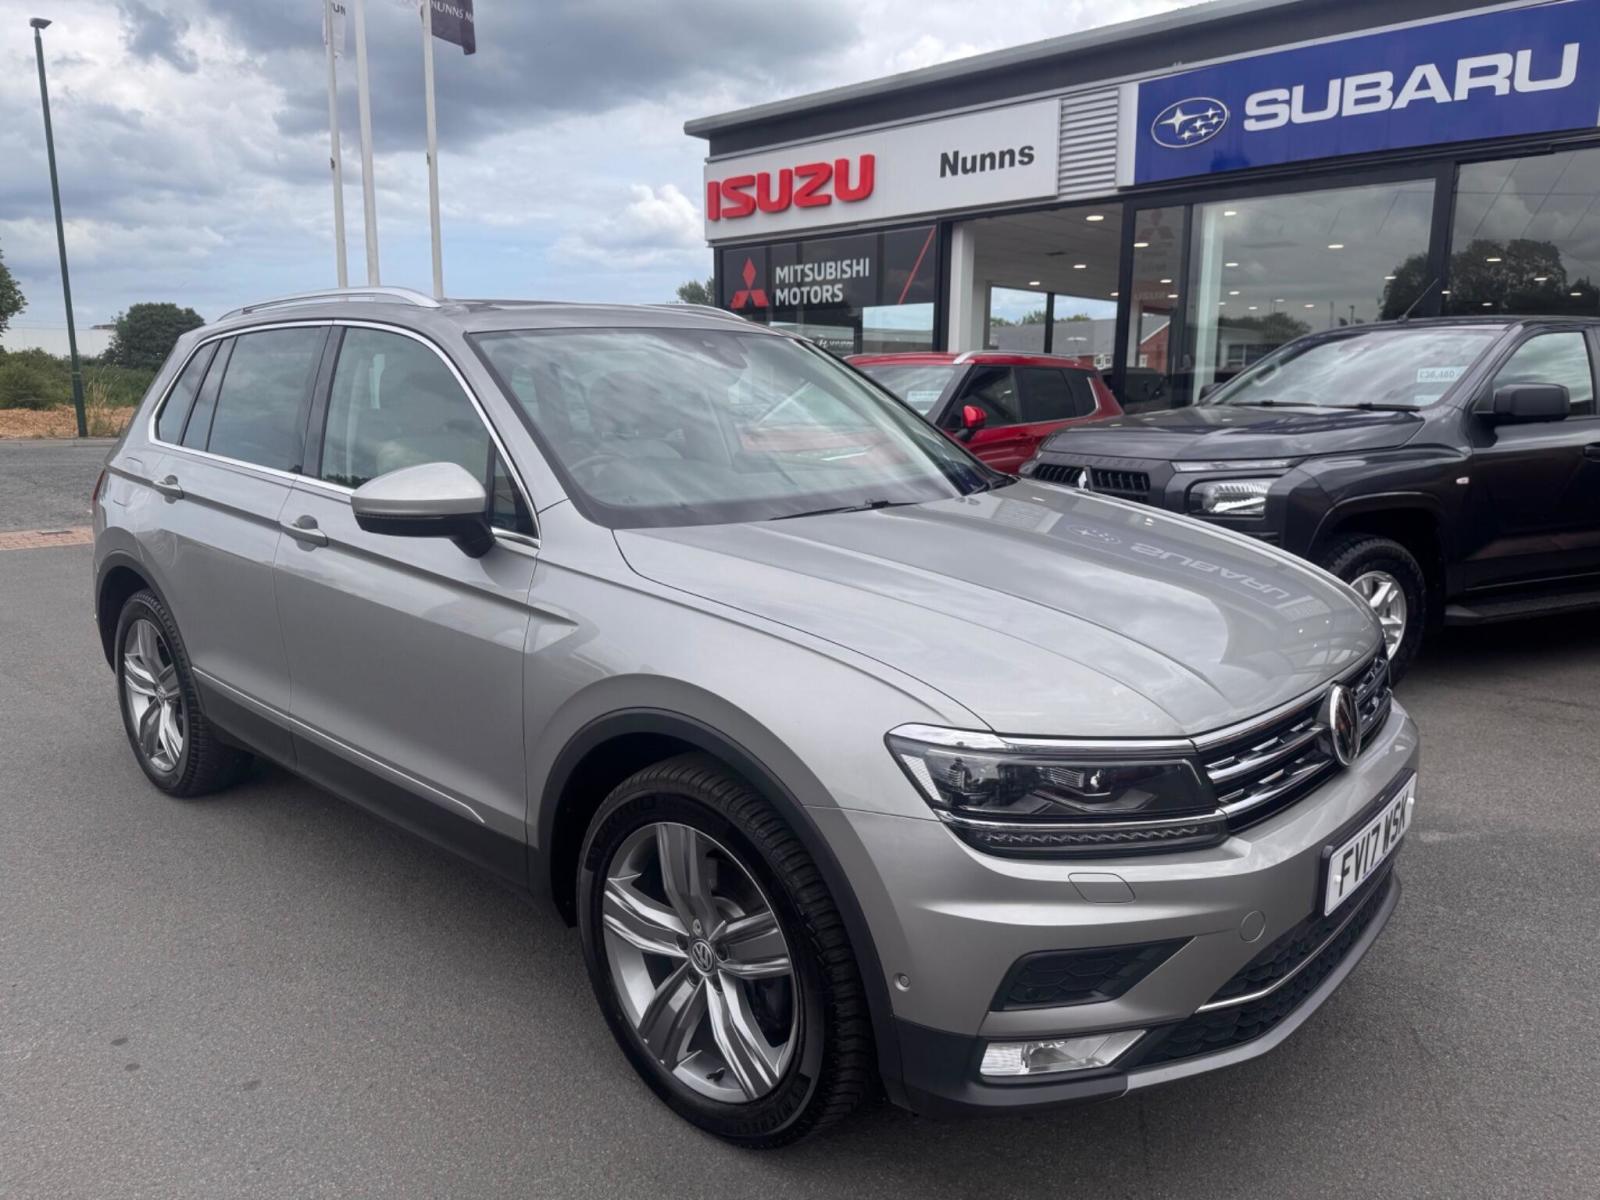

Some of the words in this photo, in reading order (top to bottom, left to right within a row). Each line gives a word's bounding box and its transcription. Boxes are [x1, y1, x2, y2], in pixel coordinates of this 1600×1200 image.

[1243, 42, 1580, 132] SUBARU
[940, 145, 1035, 178] Nunns
[707, 154, 876, 221] ISUZU
[775, 257, 870, 284] MITSUBISHI
[775, 283, 844, 306] MOTORS
[1338, 821, 1382, 897] FV17
